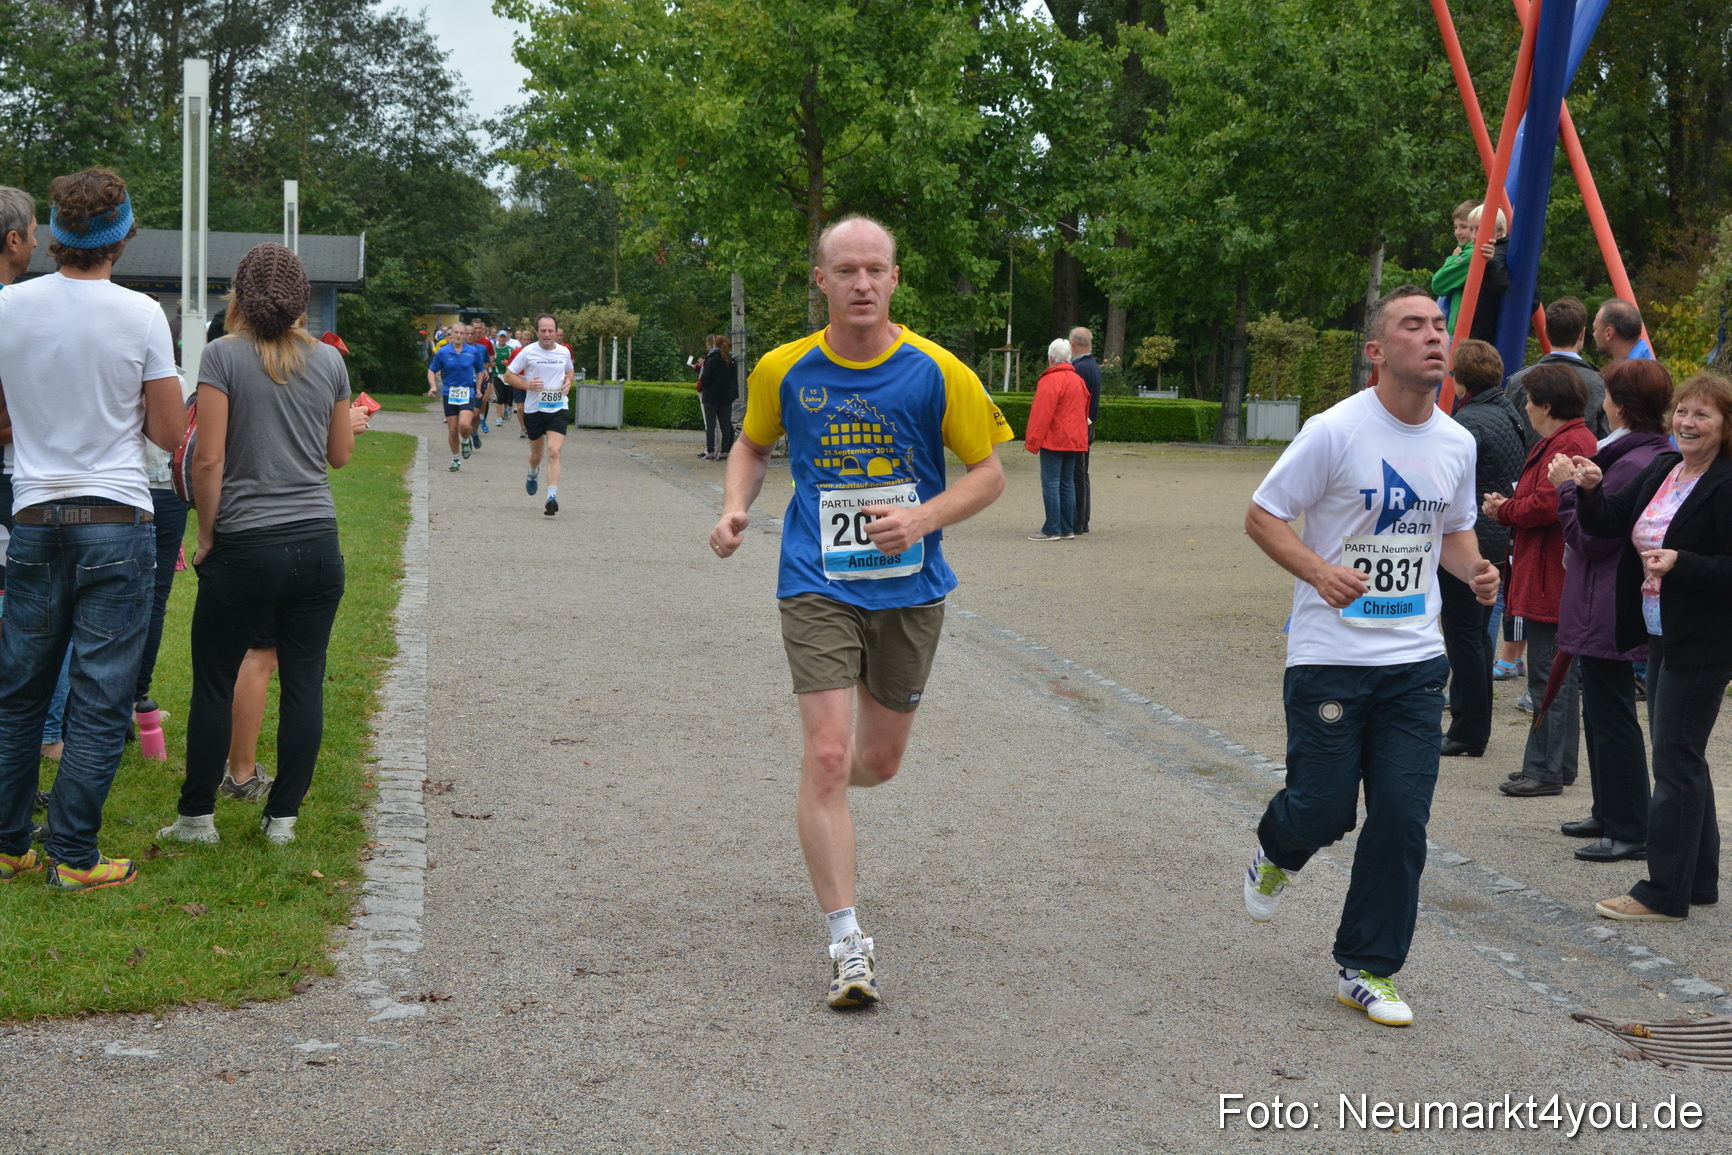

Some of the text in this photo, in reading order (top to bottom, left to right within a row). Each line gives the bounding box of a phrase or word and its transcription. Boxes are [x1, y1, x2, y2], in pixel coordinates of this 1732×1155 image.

[541, 391, 562, 402] 2689
[823, 448, 874, 456] 21.September
[818, 477, 912, 489] www.stadtlauf-neumarkt.de
[821, 495, 904, 509] PARTL Neumarkt
[1391, 517, 1432, 535] Team
[1345, 543, 1422, 554] PARTL Neumarkt
[848, 553, 902, 569] Andreas
[1353, 557, 1423, 593] 2831
[1363, 601, 1413, 615] Christian
